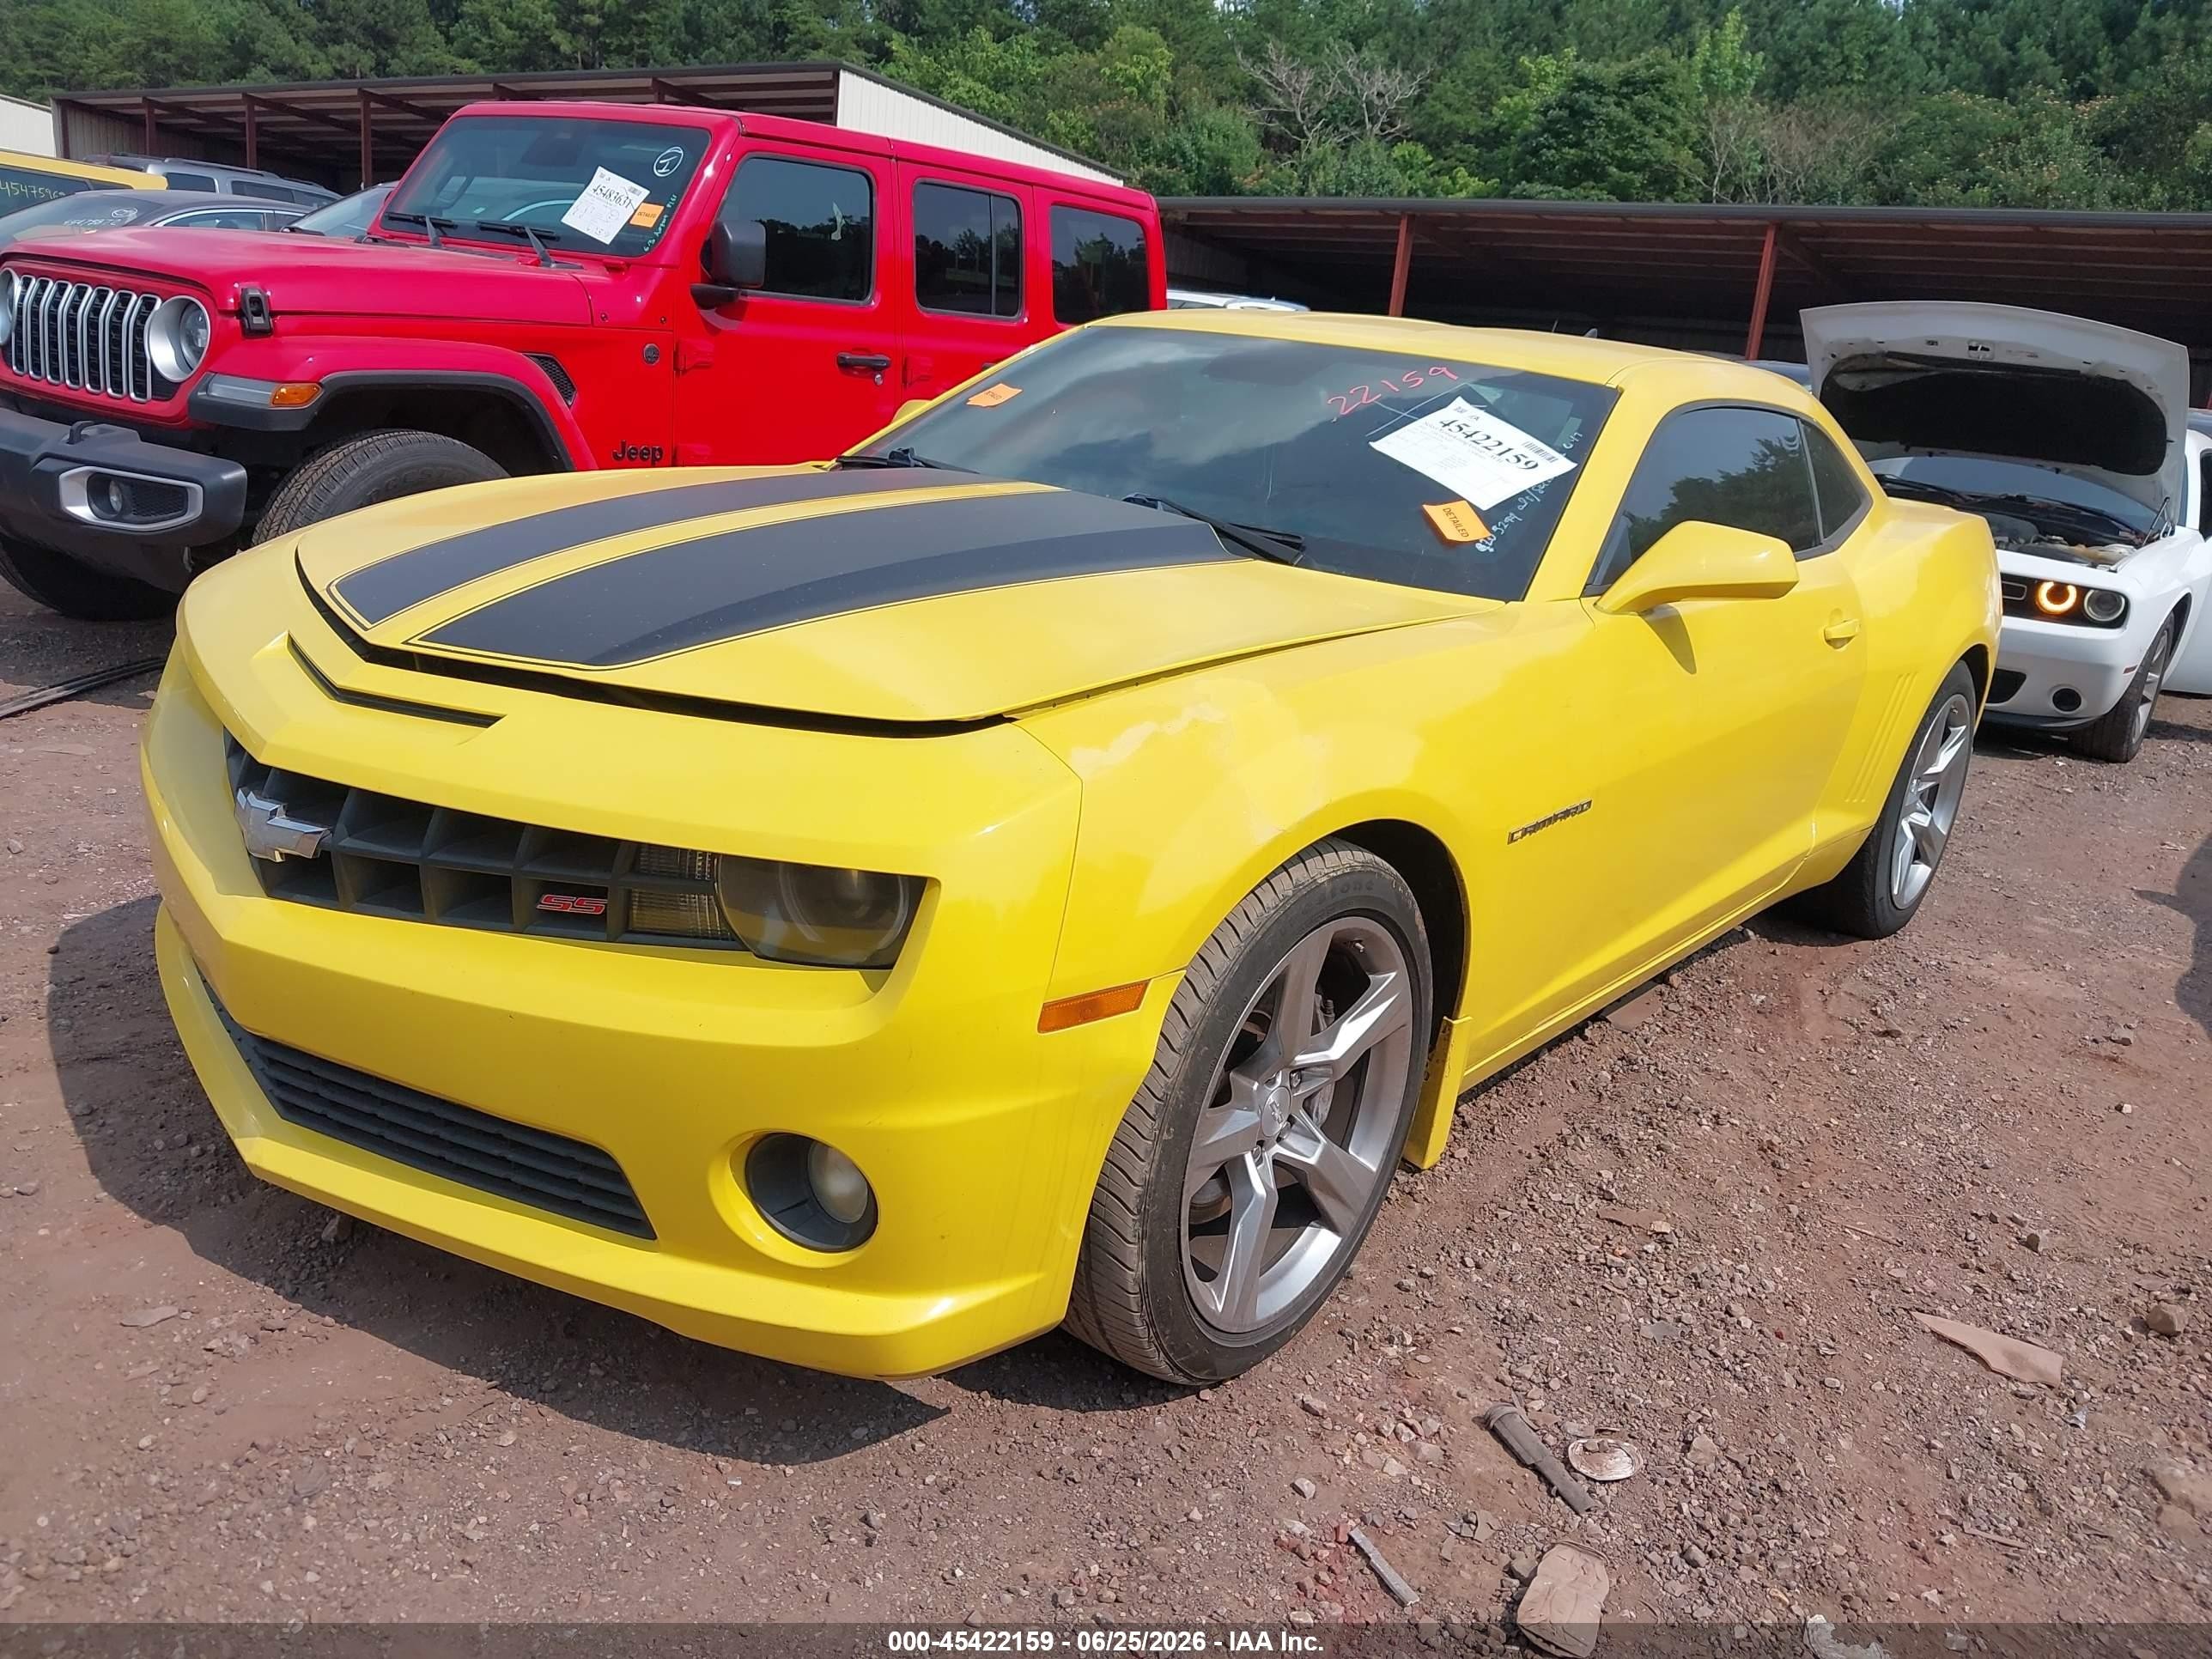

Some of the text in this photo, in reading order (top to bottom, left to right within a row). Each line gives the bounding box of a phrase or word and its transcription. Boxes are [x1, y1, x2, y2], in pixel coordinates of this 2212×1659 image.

[1327, 366, 1459, 416] 22159
[612, 440, 664, 465] Jeep
[1439, 419, 1539, 470] 45422159
[1442, 507, 1469, 538] DETAILED
[1507, 799, 1593, 845] CAMARO
[536, 894, 609, 915] SS
